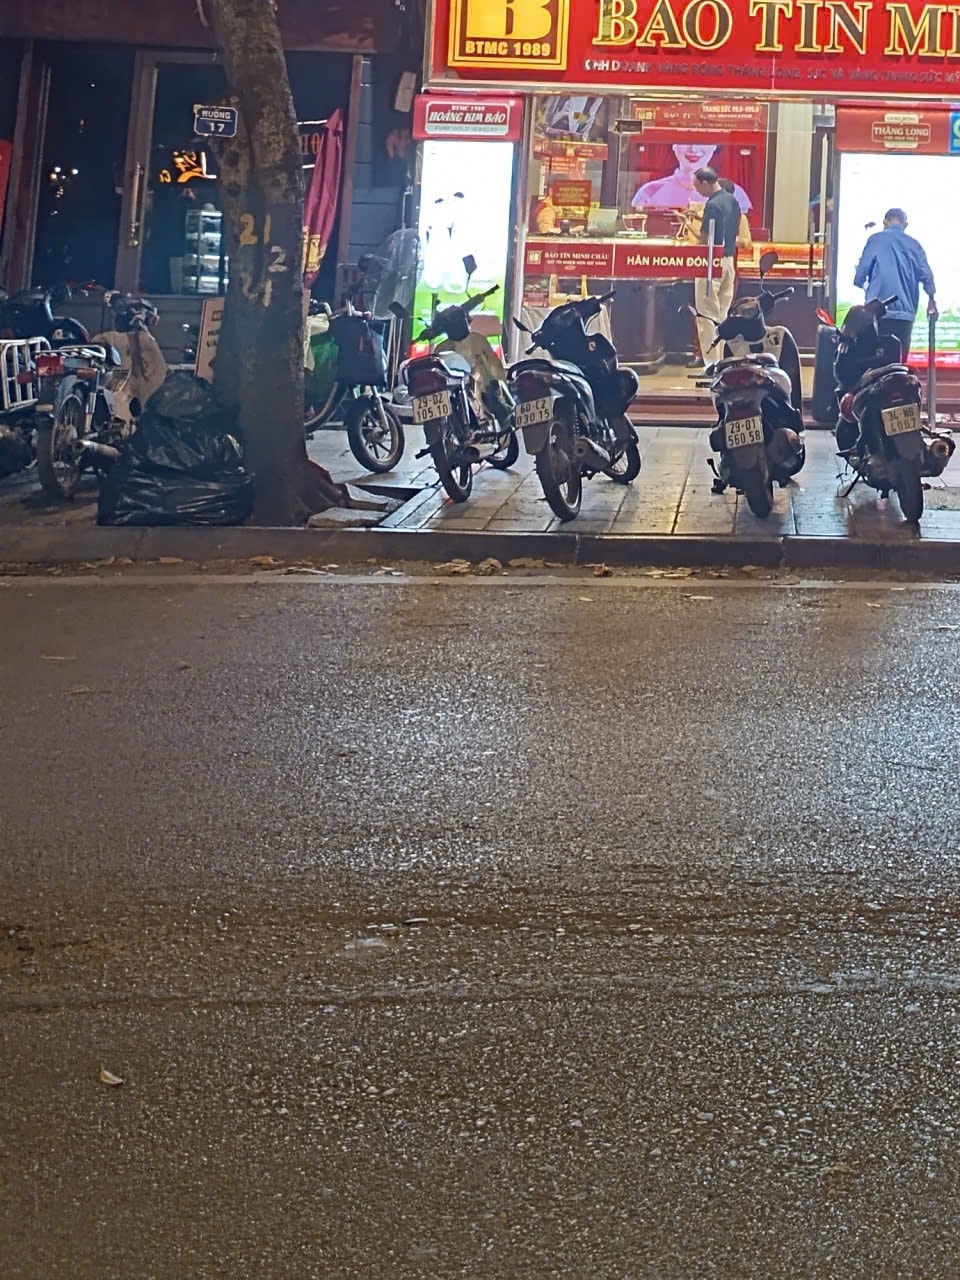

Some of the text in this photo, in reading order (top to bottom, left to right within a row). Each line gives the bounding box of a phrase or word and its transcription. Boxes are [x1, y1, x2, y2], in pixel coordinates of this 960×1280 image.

[465, 41, 551, 57] BTMC 1989
[463, 112, 484, 122] KIM
[208, 122, 225, 133] 17
[905, 127, 929, 137] LONG
[267, 245, 288, 273] 2
[653, 257, 684, 267] HOAN
[416, 403, 449, 421] 105.10
